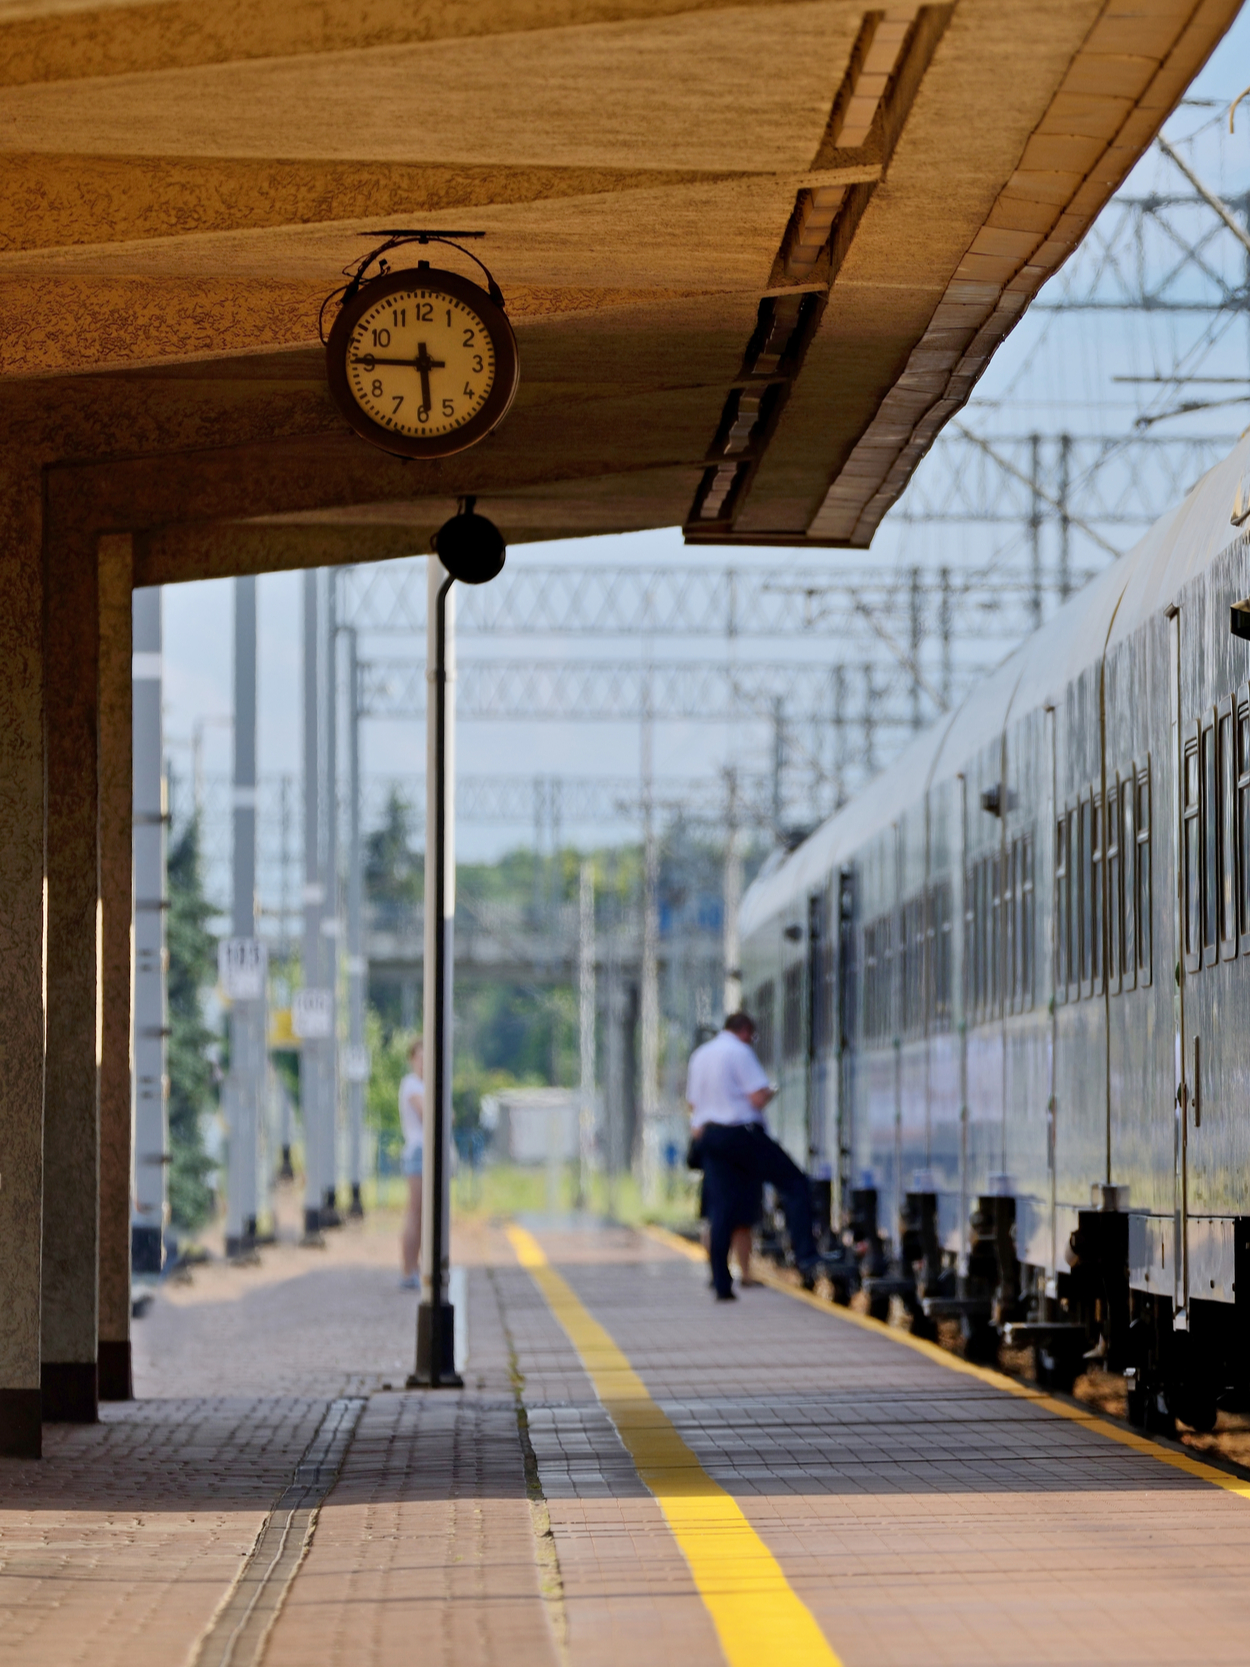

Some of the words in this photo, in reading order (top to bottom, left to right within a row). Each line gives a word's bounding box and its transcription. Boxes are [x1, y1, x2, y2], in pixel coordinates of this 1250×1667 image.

[392, 308, 406, 327] 11
[416, 303, 433, 321] 12
[446, 309, 451, 327] 1
[371, 328, 391, 348] 10
[462, 329, 474, 347] 2
[363, 353, 375, 372] 9
[472, 354, 483, 373] 3
[372, 379, 383, 398] 8
[463, 381, 475, 400] 4
[391, 396, 404, 414] 7
[417, 404, 429, 423] 6
[442, 399, 454, 417] 5
